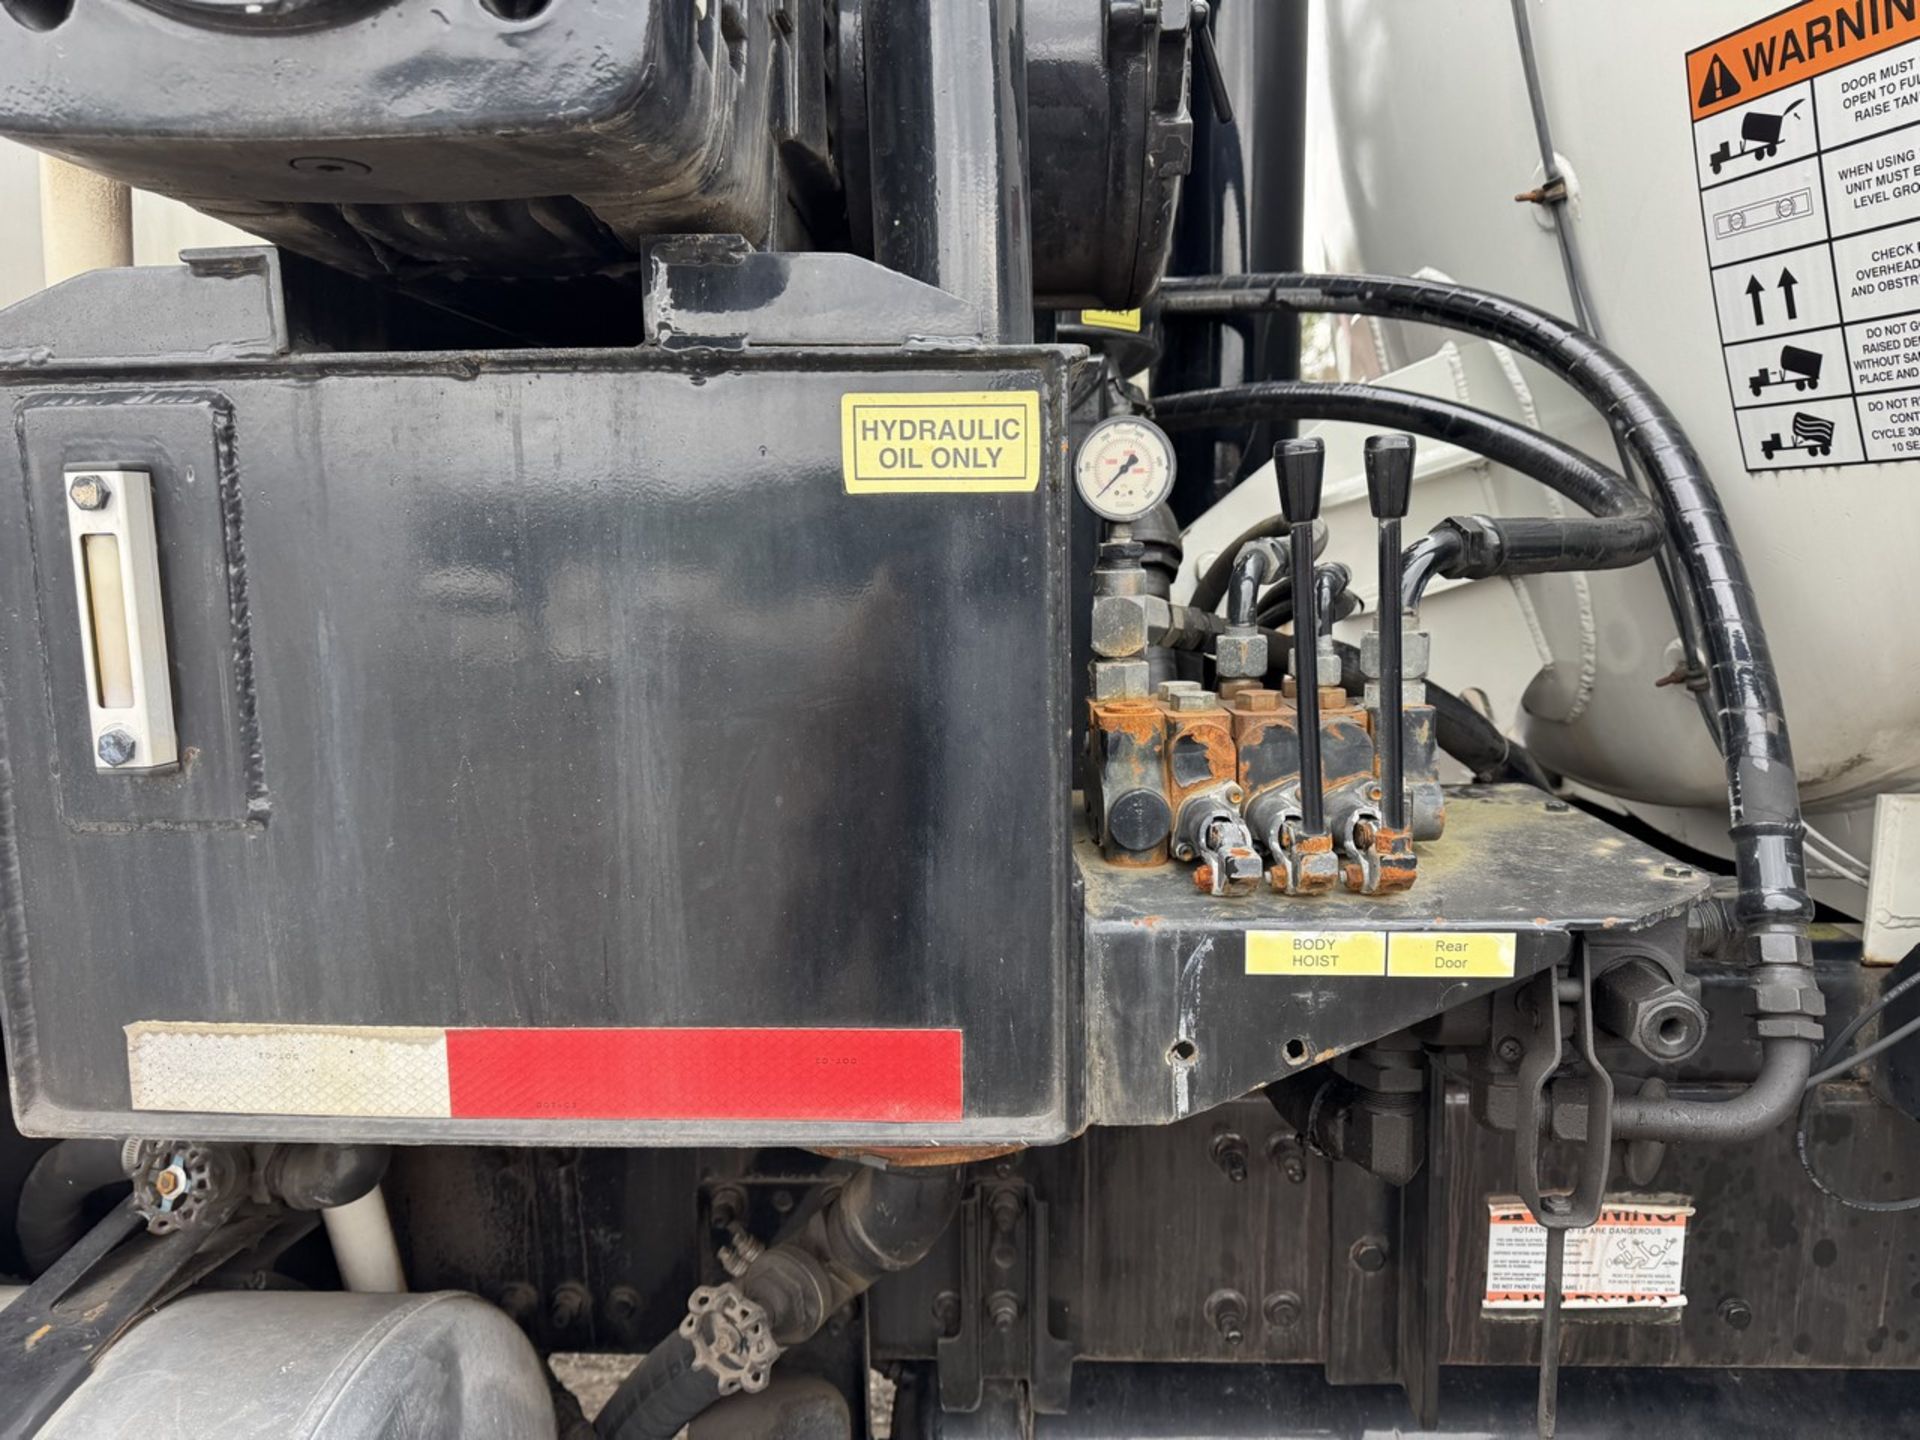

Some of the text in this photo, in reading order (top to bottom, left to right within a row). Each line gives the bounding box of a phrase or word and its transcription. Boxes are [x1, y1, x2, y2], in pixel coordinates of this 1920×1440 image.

[1841, 58, 1915, 94] DOOR MUST
[1843, 89, 1876, 110] OPEN
[1879, 82, 1897, 97] TO
[1855, 91, 1920, 122] RAISE TAN
[1838, 149, 1915, 180] WHEN USING
[1846, 178, 1872, 195] UNIT
[1875, 167, 1910, 187] MUST
[1853, 190, 1890, 209] LEVEL
[1871, 243, 1914, 262] CHECK
[1856, 258, 1920, 281] OVERHEAD
[1851, 274, 1920, 298] AND OBSTR
[1866, 320, 1920, 339] DO NOT G
[1862, 339, 1901, 354] RAISED
[1853, 354, 1901, 370] WITHOUT
[1859, 366, 1919, 384] PLACE AND
[1868, 396, 1920, 412] DO NOT R
[862, 418, 1021, 441] HYDRAULIC
[1871, 427, 1906, 440] CYCLE
[1892, 442, 1904, 452] 10
[878, 447, 1003, 469] OIL ONLY
[1293, 938, 1336, 951] BODY
[1435, 940, 1469, 952] Rear
[1292, 955, 1339, 967] HOIST
[1435, 957, 1468, 969] Door
[1608, 1227, 1662, 1236] DANGEROUS
